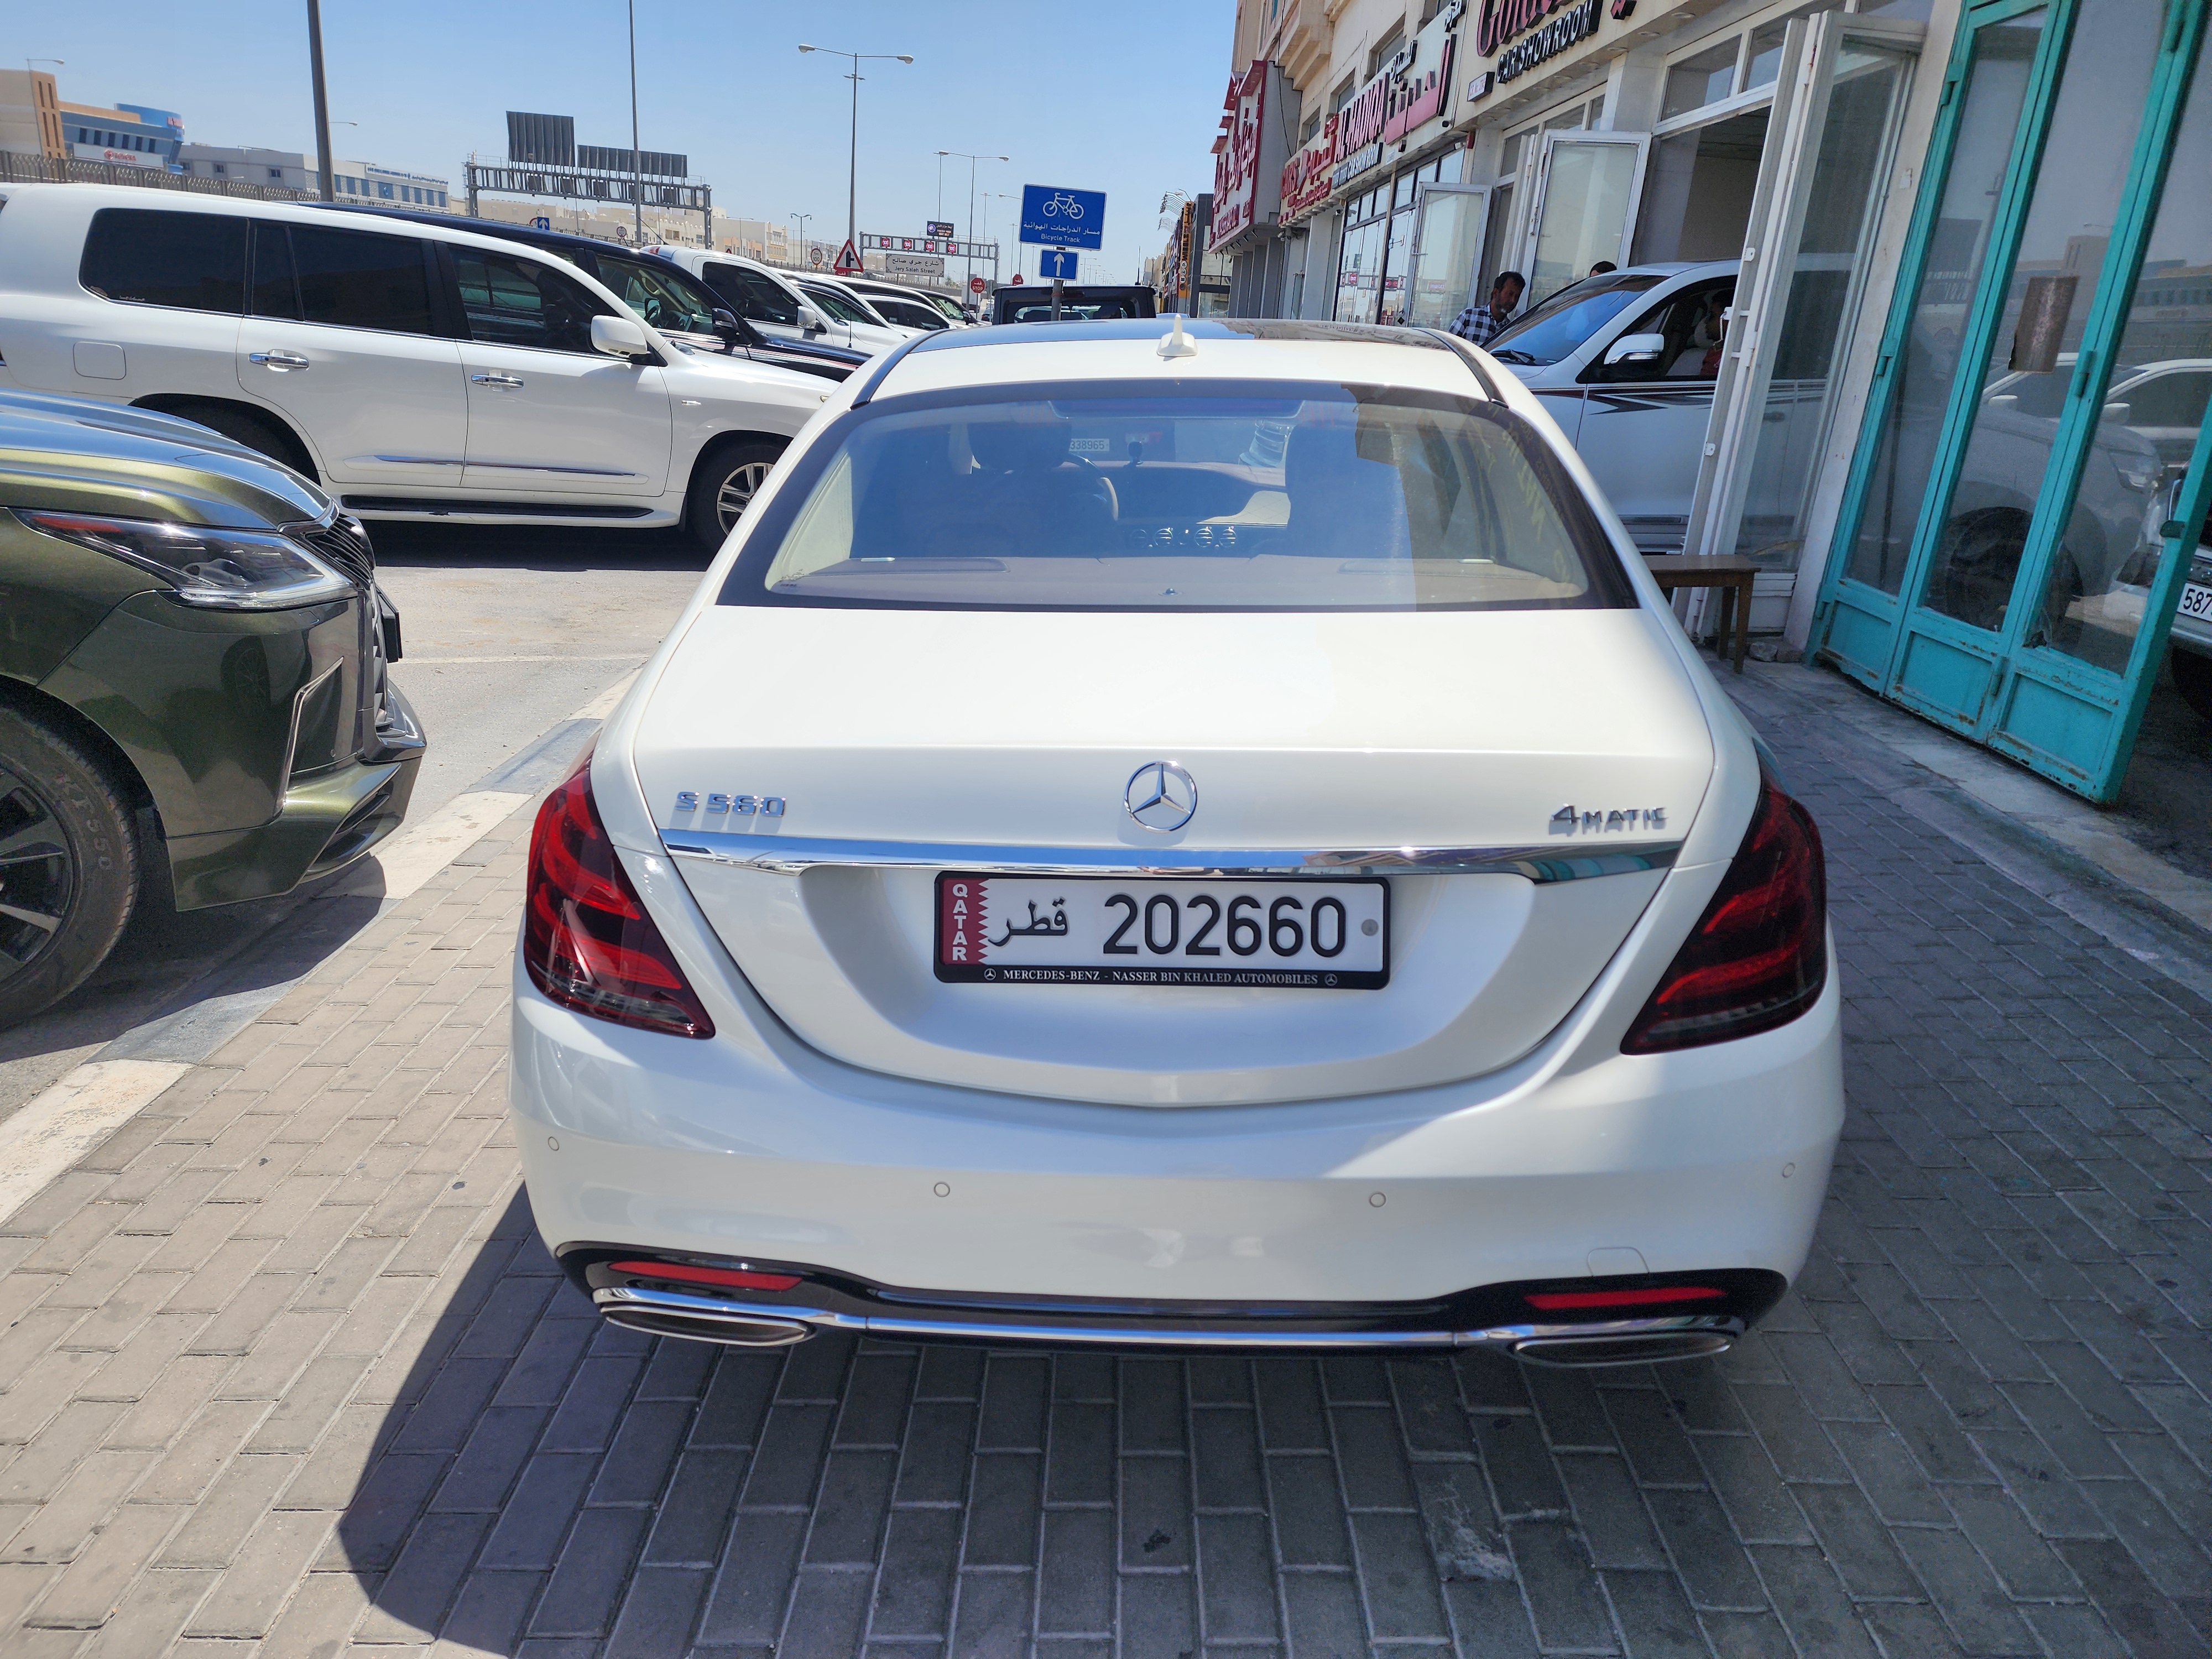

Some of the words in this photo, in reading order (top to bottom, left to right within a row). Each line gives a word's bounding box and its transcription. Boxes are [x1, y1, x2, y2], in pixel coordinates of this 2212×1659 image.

[1497, 45, 1520, 83] CAR
[1519, 0, 1595, 70] SHOWROOM
[1281, 158, 1300, 199] CARS
[1023, 221, 1048, 231] الهوائية
[1051, 225, 1081, 233] الدراجات
[1550, 803, 1668, 825] 4MATIC
[952, 884, 968, 961] QATAR
[988, 897, 1069, 947] قطر
[1103, 894, 1348, 958] 202660
[1003, 969, 1100, 981] MERCEDES-BENZ
[1112, 971, 1157, 982] NASSER
[1161, 972, 1181, 982] BIN
[1184, 972, 1232, 983] KHALED
[1234, 972, 1318, 985] AUTOMOBILES
